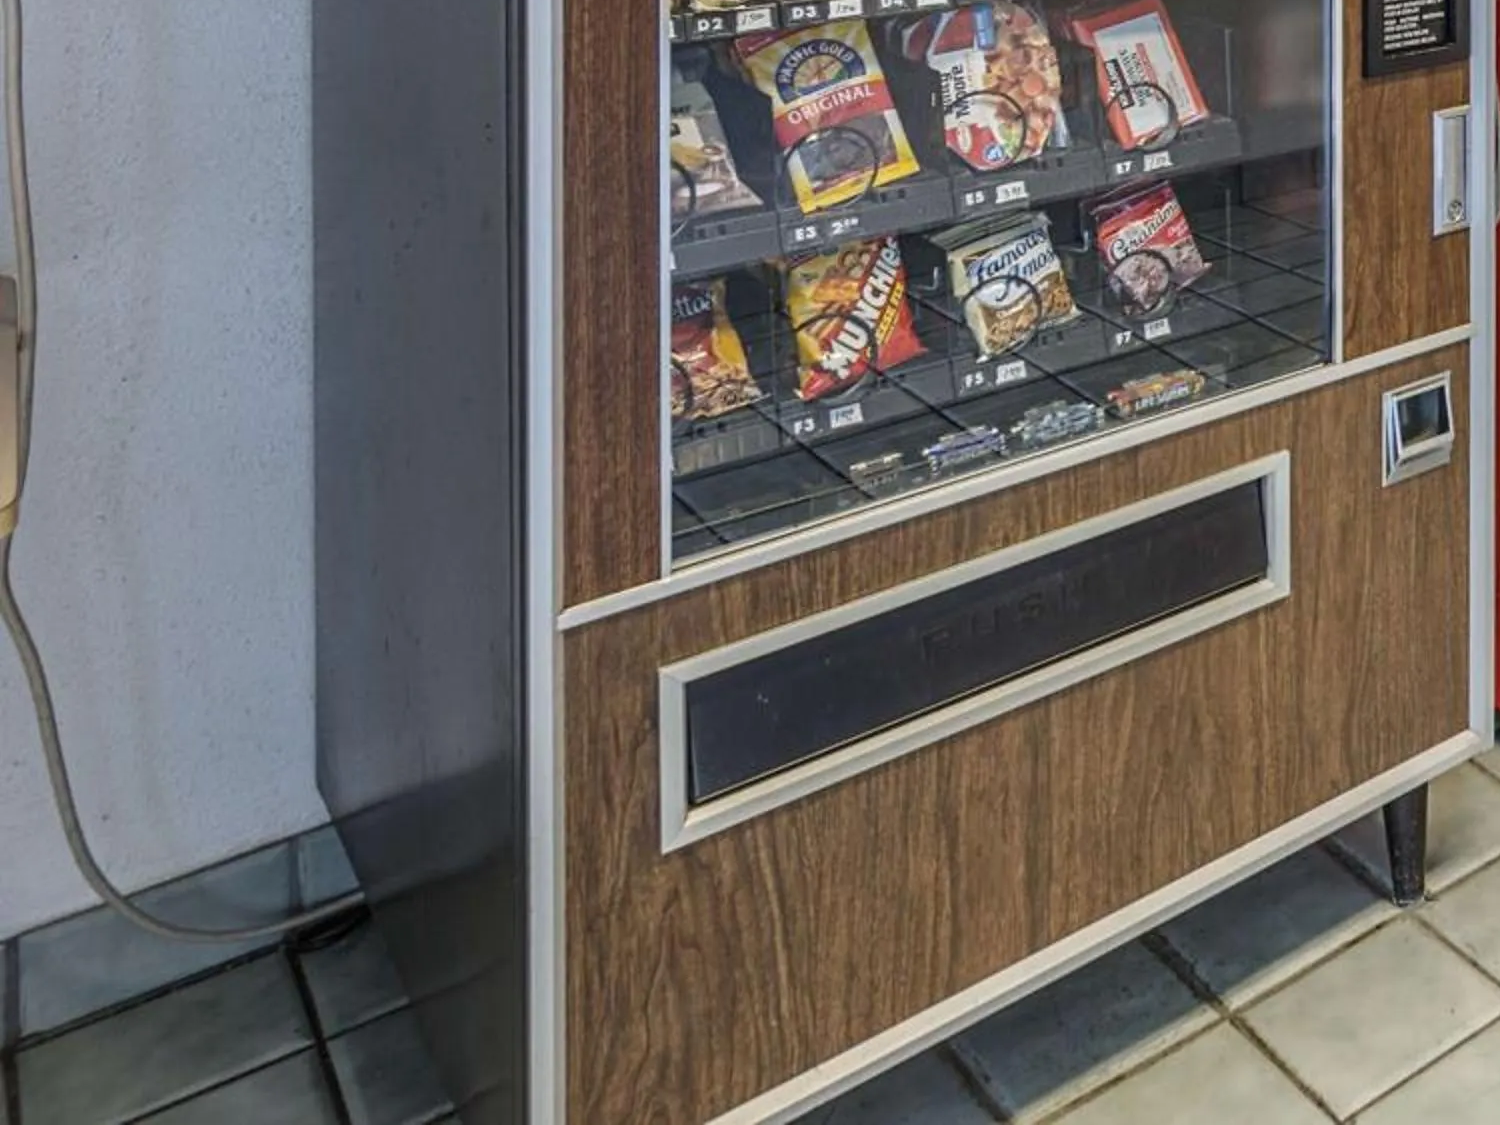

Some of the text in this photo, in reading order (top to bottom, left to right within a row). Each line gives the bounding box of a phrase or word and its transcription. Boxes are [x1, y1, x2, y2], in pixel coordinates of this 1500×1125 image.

[791, 6, 816, 20] D3
[697, 17, 724, 32] D2
[777, 43, 856, 84] PACIFIC GOLD
[787, 84, 876, 125] ORIGINAL
[1115, 161, 1133, 173] E7
[964, 191, 984, 205] E5
[794, 227, 817, 241] E3
[972, 227, 1048, 278] Famous
[964, 373, 984, 387] F5
[793, 418, 815, 435] F3
